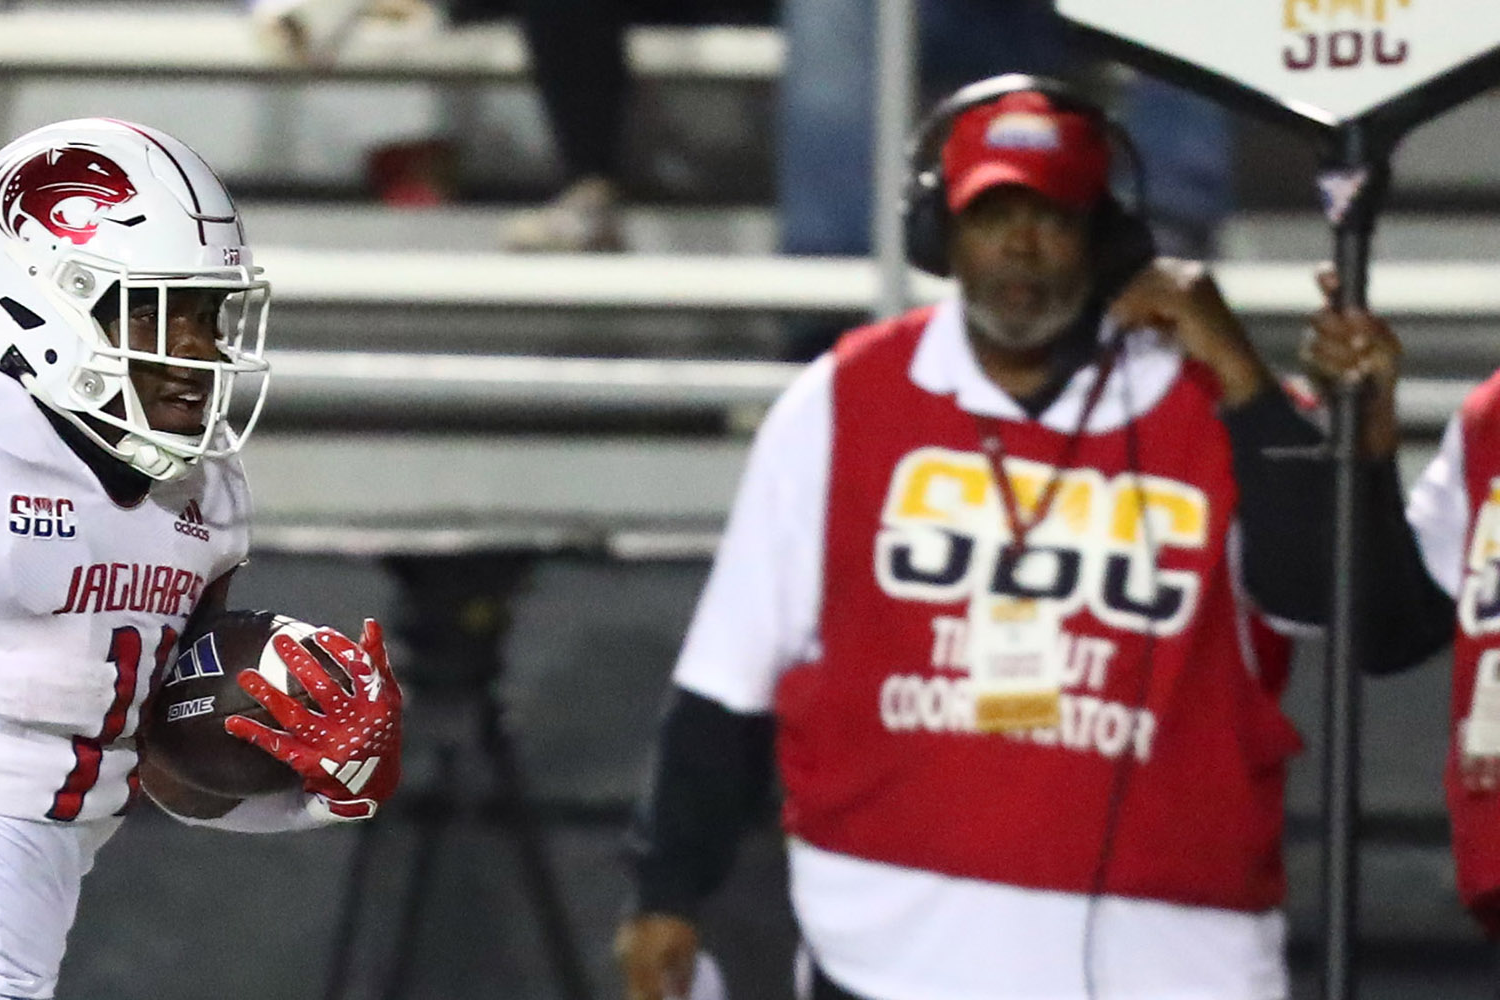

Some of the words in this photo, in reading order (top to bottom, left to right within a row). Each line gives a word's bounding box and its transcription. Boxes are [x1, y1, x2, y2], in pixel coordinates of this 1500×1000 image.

[8, 494, 77, 540] SBC
[174, 520, 210, 542] adidas
[878, 450, 1206, 632] SBC
[167, 696, 216, 721] DIME
